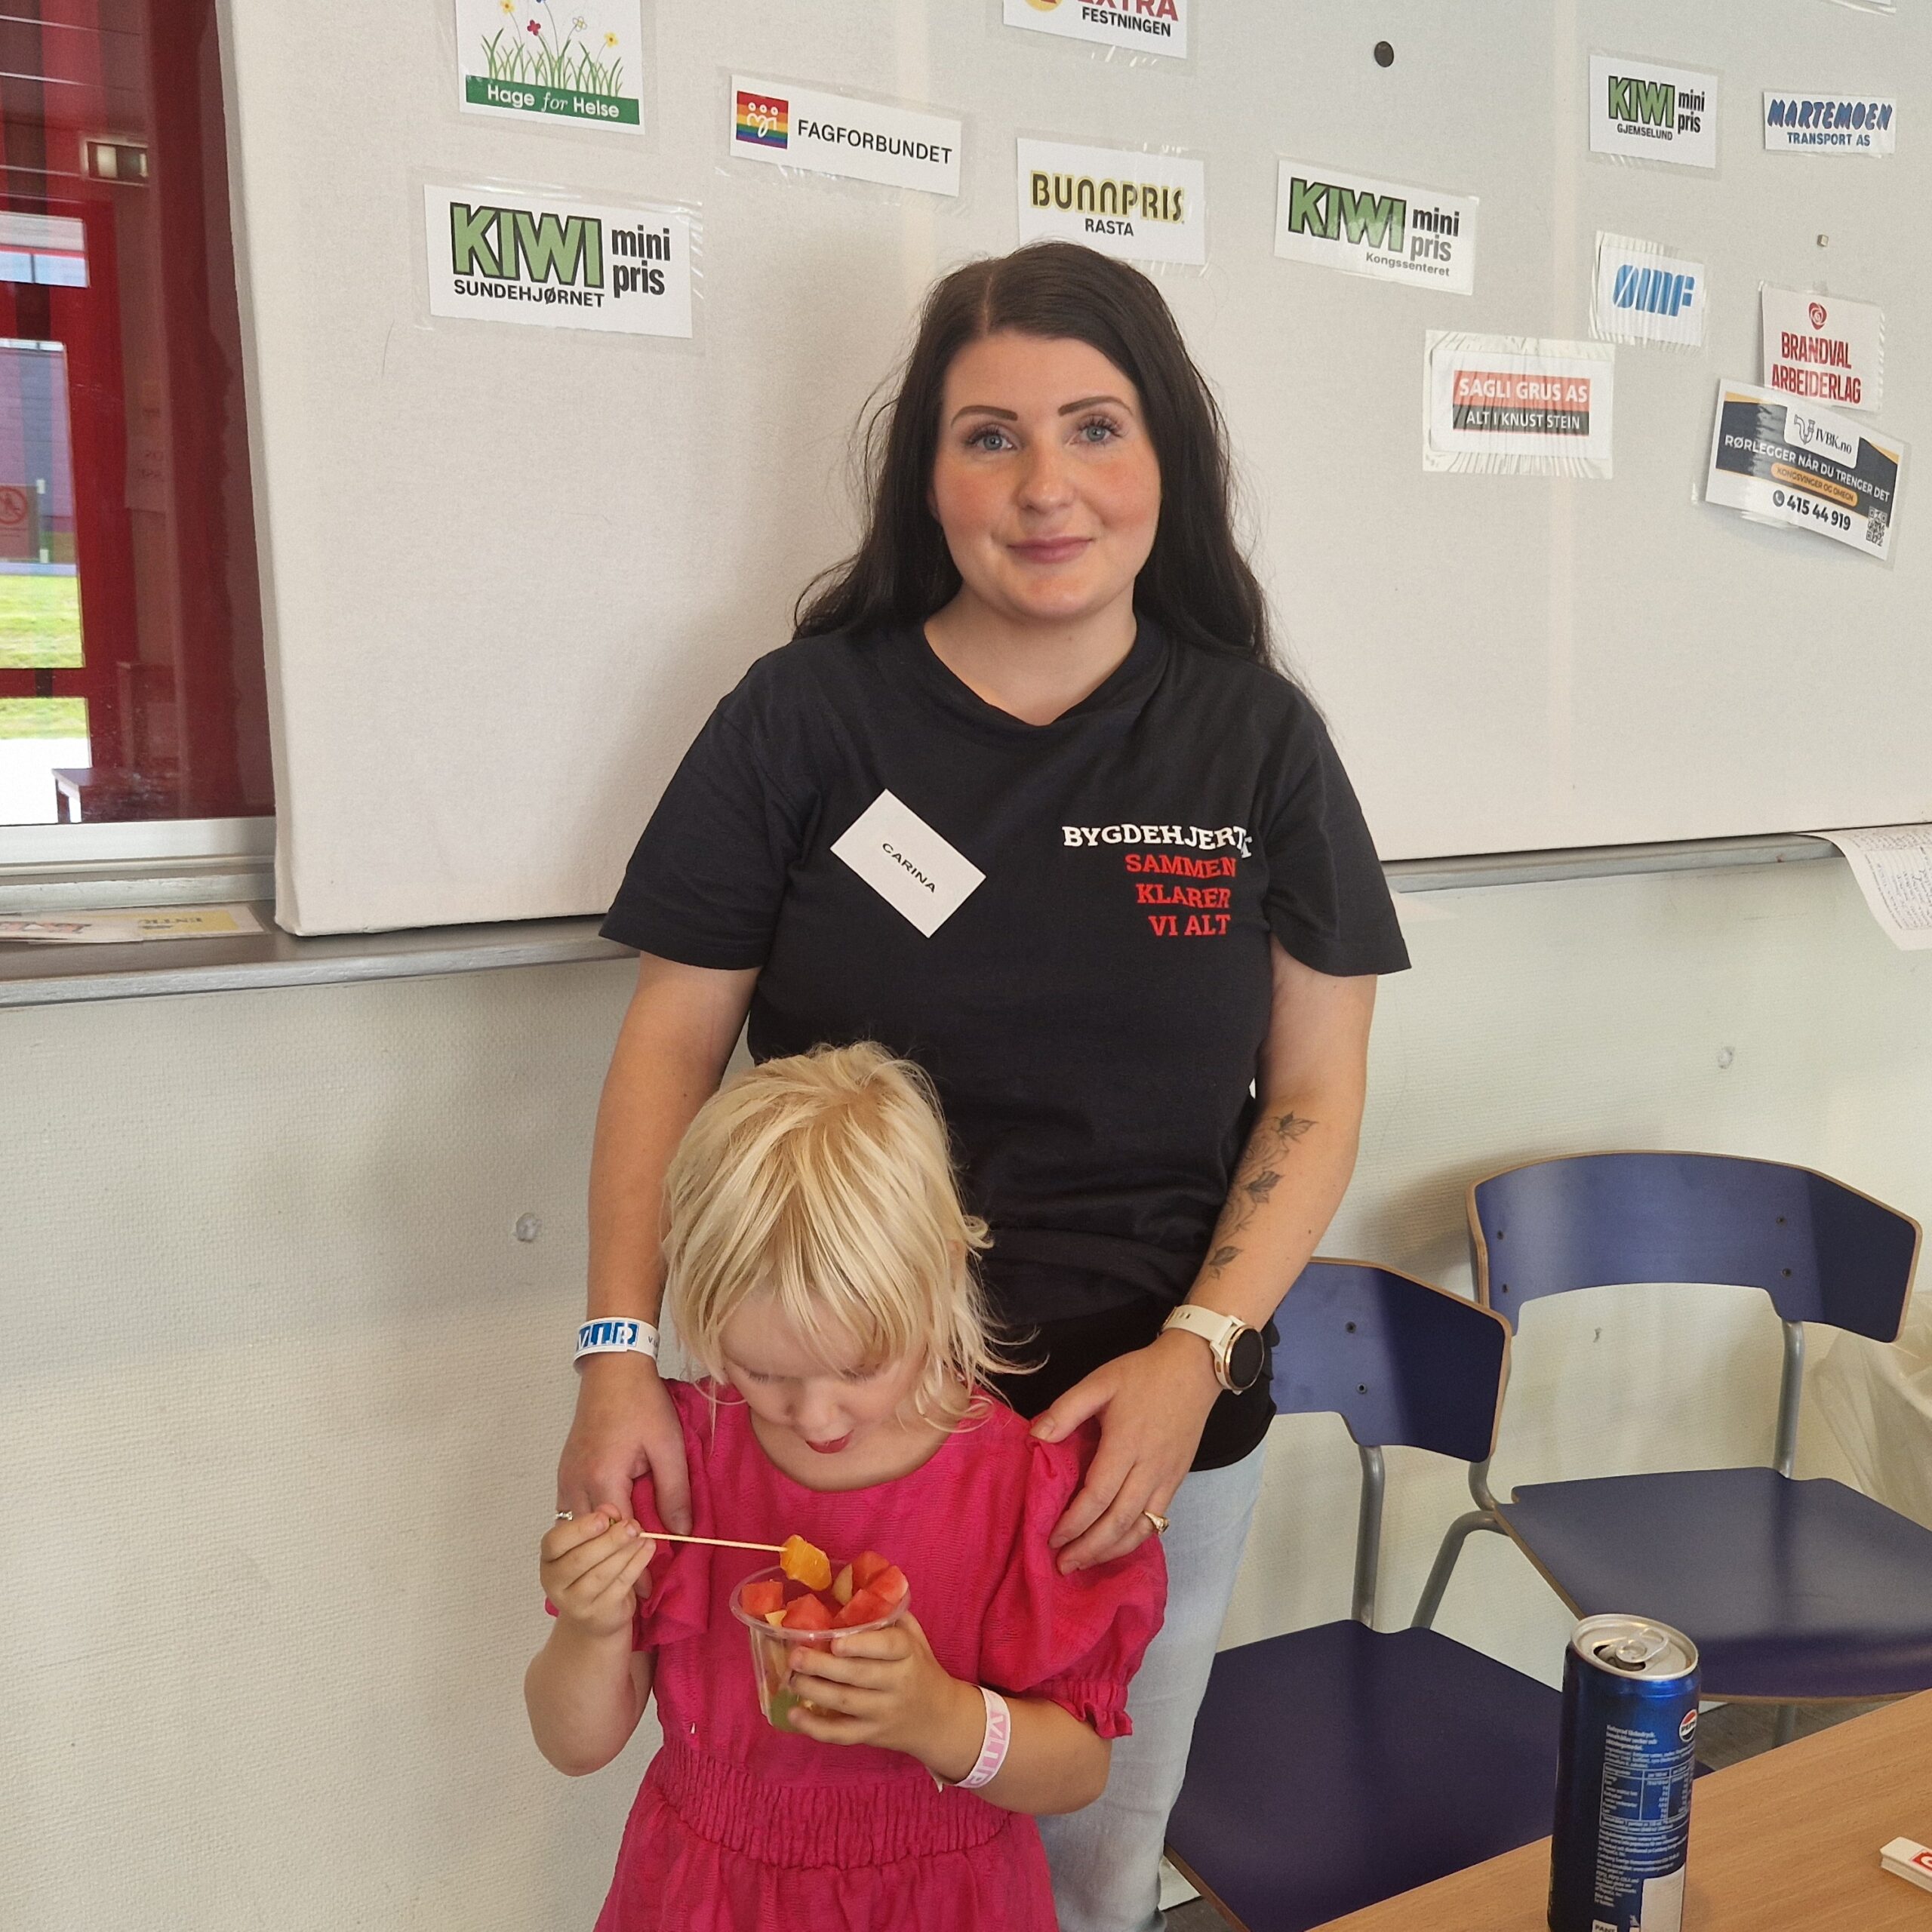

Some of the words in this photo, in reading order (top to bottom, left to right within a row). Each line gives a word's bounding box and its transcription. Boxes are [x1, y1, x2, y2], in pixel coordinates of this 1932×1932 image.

[1082, 6, 1171, 37] FESTNINGEN
[488, 85, 535, 109] Hage
[540, 91, 568, 113] for
[573, 94, 620, 118] Helse
[1608, 75, 1675, 128] KIWI
[1678, 89, 1705, 112] mini
[1767, 99, 1893, 131] MARTEMOEN
[1617, 123, 1673, 141] GJEMSELUND
[1678, 111, 1701, 134] pris
[798, 119, 952, 164] FAGFORBUNDET
[1787, 132, 1852, 146] TRANSPORT
[1856, 134, 1871, 146] AS
[1030, 170, 1185, 224] BUNNPRIS
[1084, 218, 1134, 237] RASTA
[1288, 177, 1407, 253] KIWI
[1412, 207, 1460, 237] mini
[450, 202, 605, 288] KIWI
[611, 225, 670, 261] mini
[1410, 235, 1451, 262] pris
[1366, 252, 1450, 277] Kongssenteret
[454, 279, 605, 307] SUNDEHJØRNET
[613, 260, 665, 299] pris
[1781, 331, 1852, 369] BRANDVAL
[1459, 377, 1511, 398] SAGLI
[1516, 382, 1561, 401] GRUS
[1565, 385, 1587, 403] AS
[1772, 364, 1861, 404] ARBEIDERLAG
[1466, 411, 1490, 425] ALT
[1494, 412, 1497, 425] I
[1501, 412, 1544, 427] KNUST
[1546, 415, 1580, 429] STEIN
[1815, 428, 1853, 454] IVBK.no
[1724, 435, 1796, 463] RØRLEGGER
[1798, 453, 1820, 472] NÅR
[1820, 463, 1835, 478] DU
[1835, 469, 1873, 494] TRENGER
[1874, 486, 1890, 503] DET
[1777, 467, 1824, 490] KONGSVINGER
[1823, 484, 1833, 493] OG
[1787, 494, 1810, 515] 415
[1812, 506, 1829, 523] 44
[1831, 510, 1851, 531] 919
[882, 843, 936, 893] CARINA
[1124, 854, 1236, 879] SAMMEN
[1136, 883, 1232, 909] KLARER
[1148, 915, 1179, 937] VI
[1183, 914, 1231, 936] ALT
